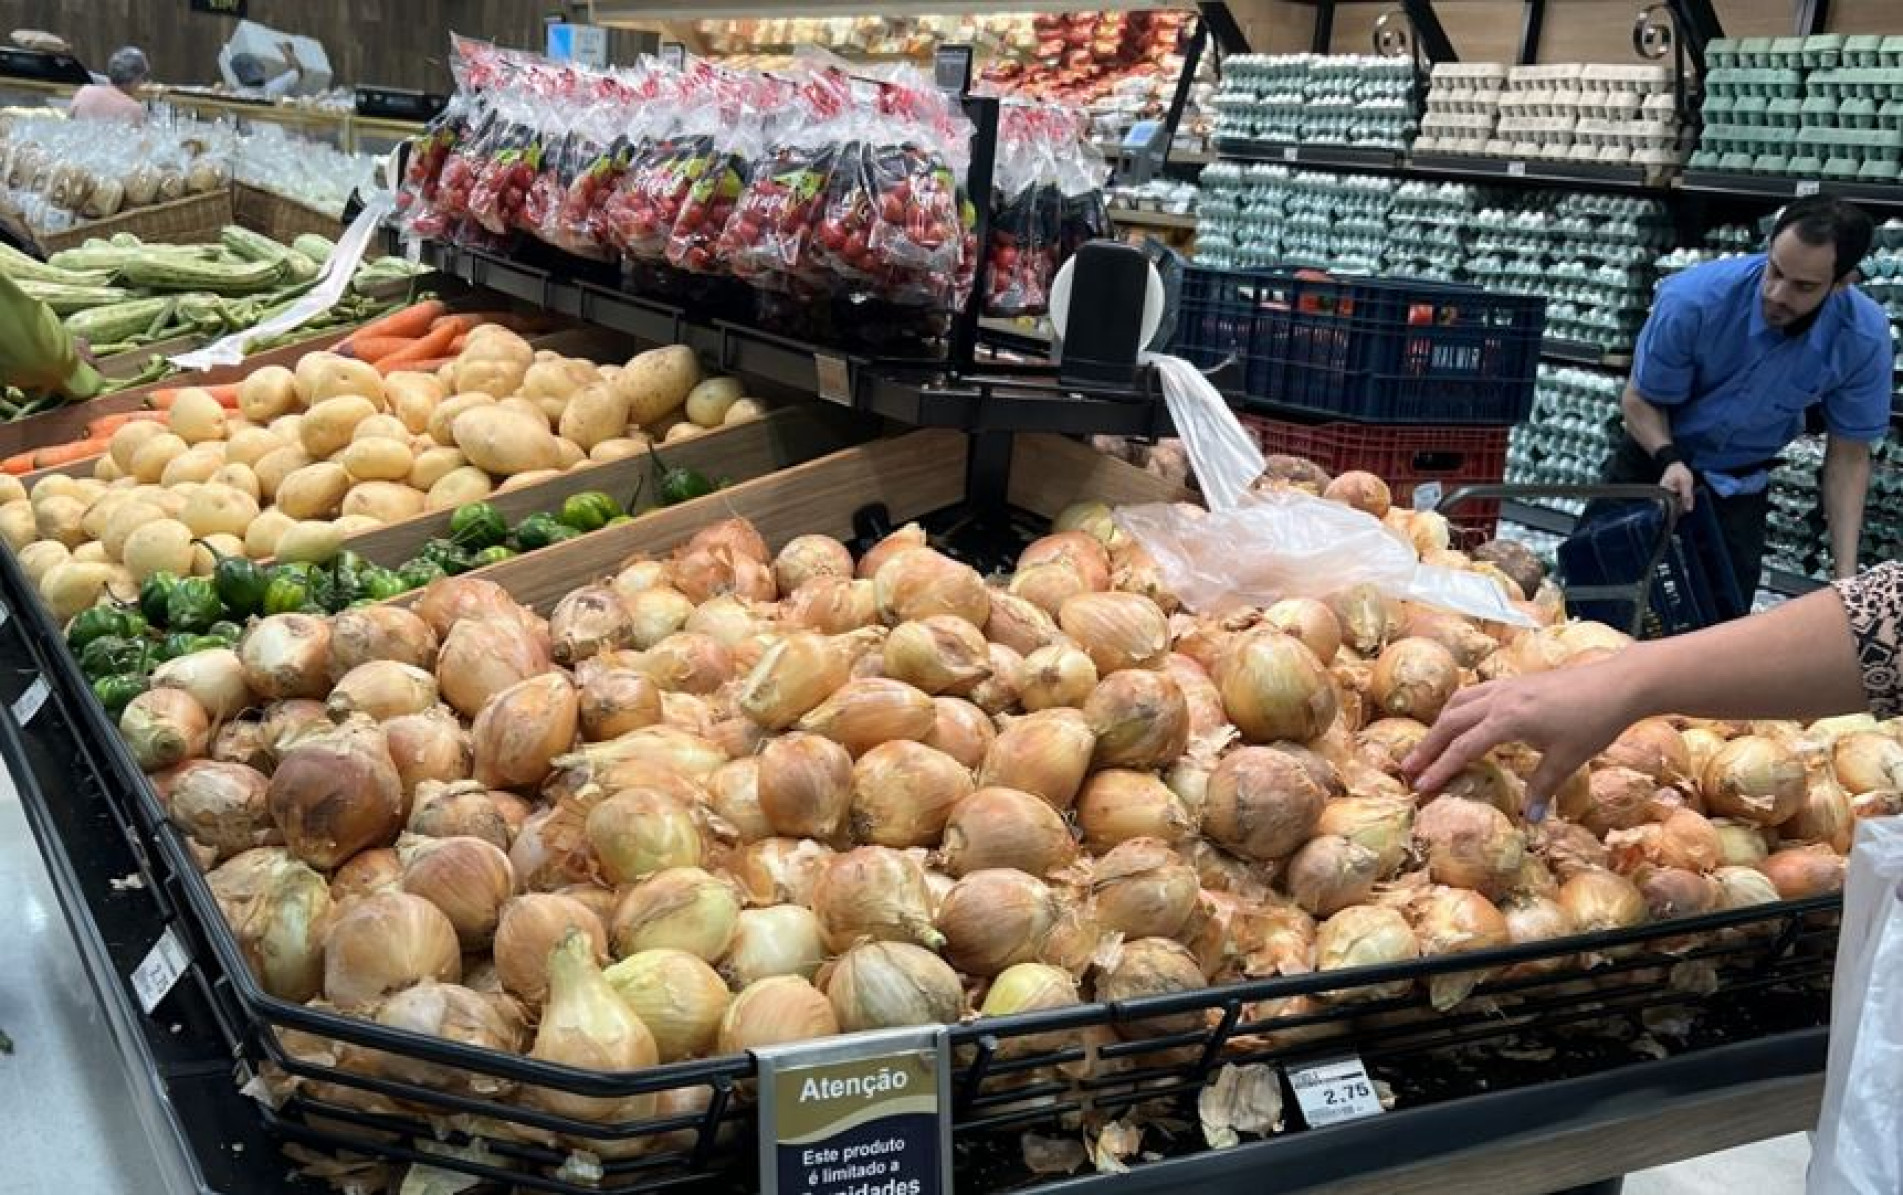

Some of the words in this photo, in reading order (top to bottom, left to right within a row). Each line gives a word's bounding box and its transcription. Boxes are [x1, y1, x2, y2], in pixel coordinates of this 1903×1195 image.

[799, 1067, 909, 1102] Atenção
[1324, 1082, 1369, 1104] 2.75
[803, 1149, 838, 1165] Este
[844, 1138, 905, 1162] produto
[808, 1170, 818, 1184] é
[822, 1162, 885, 1182] limitado
[890, 1160, 900, 1172] a
